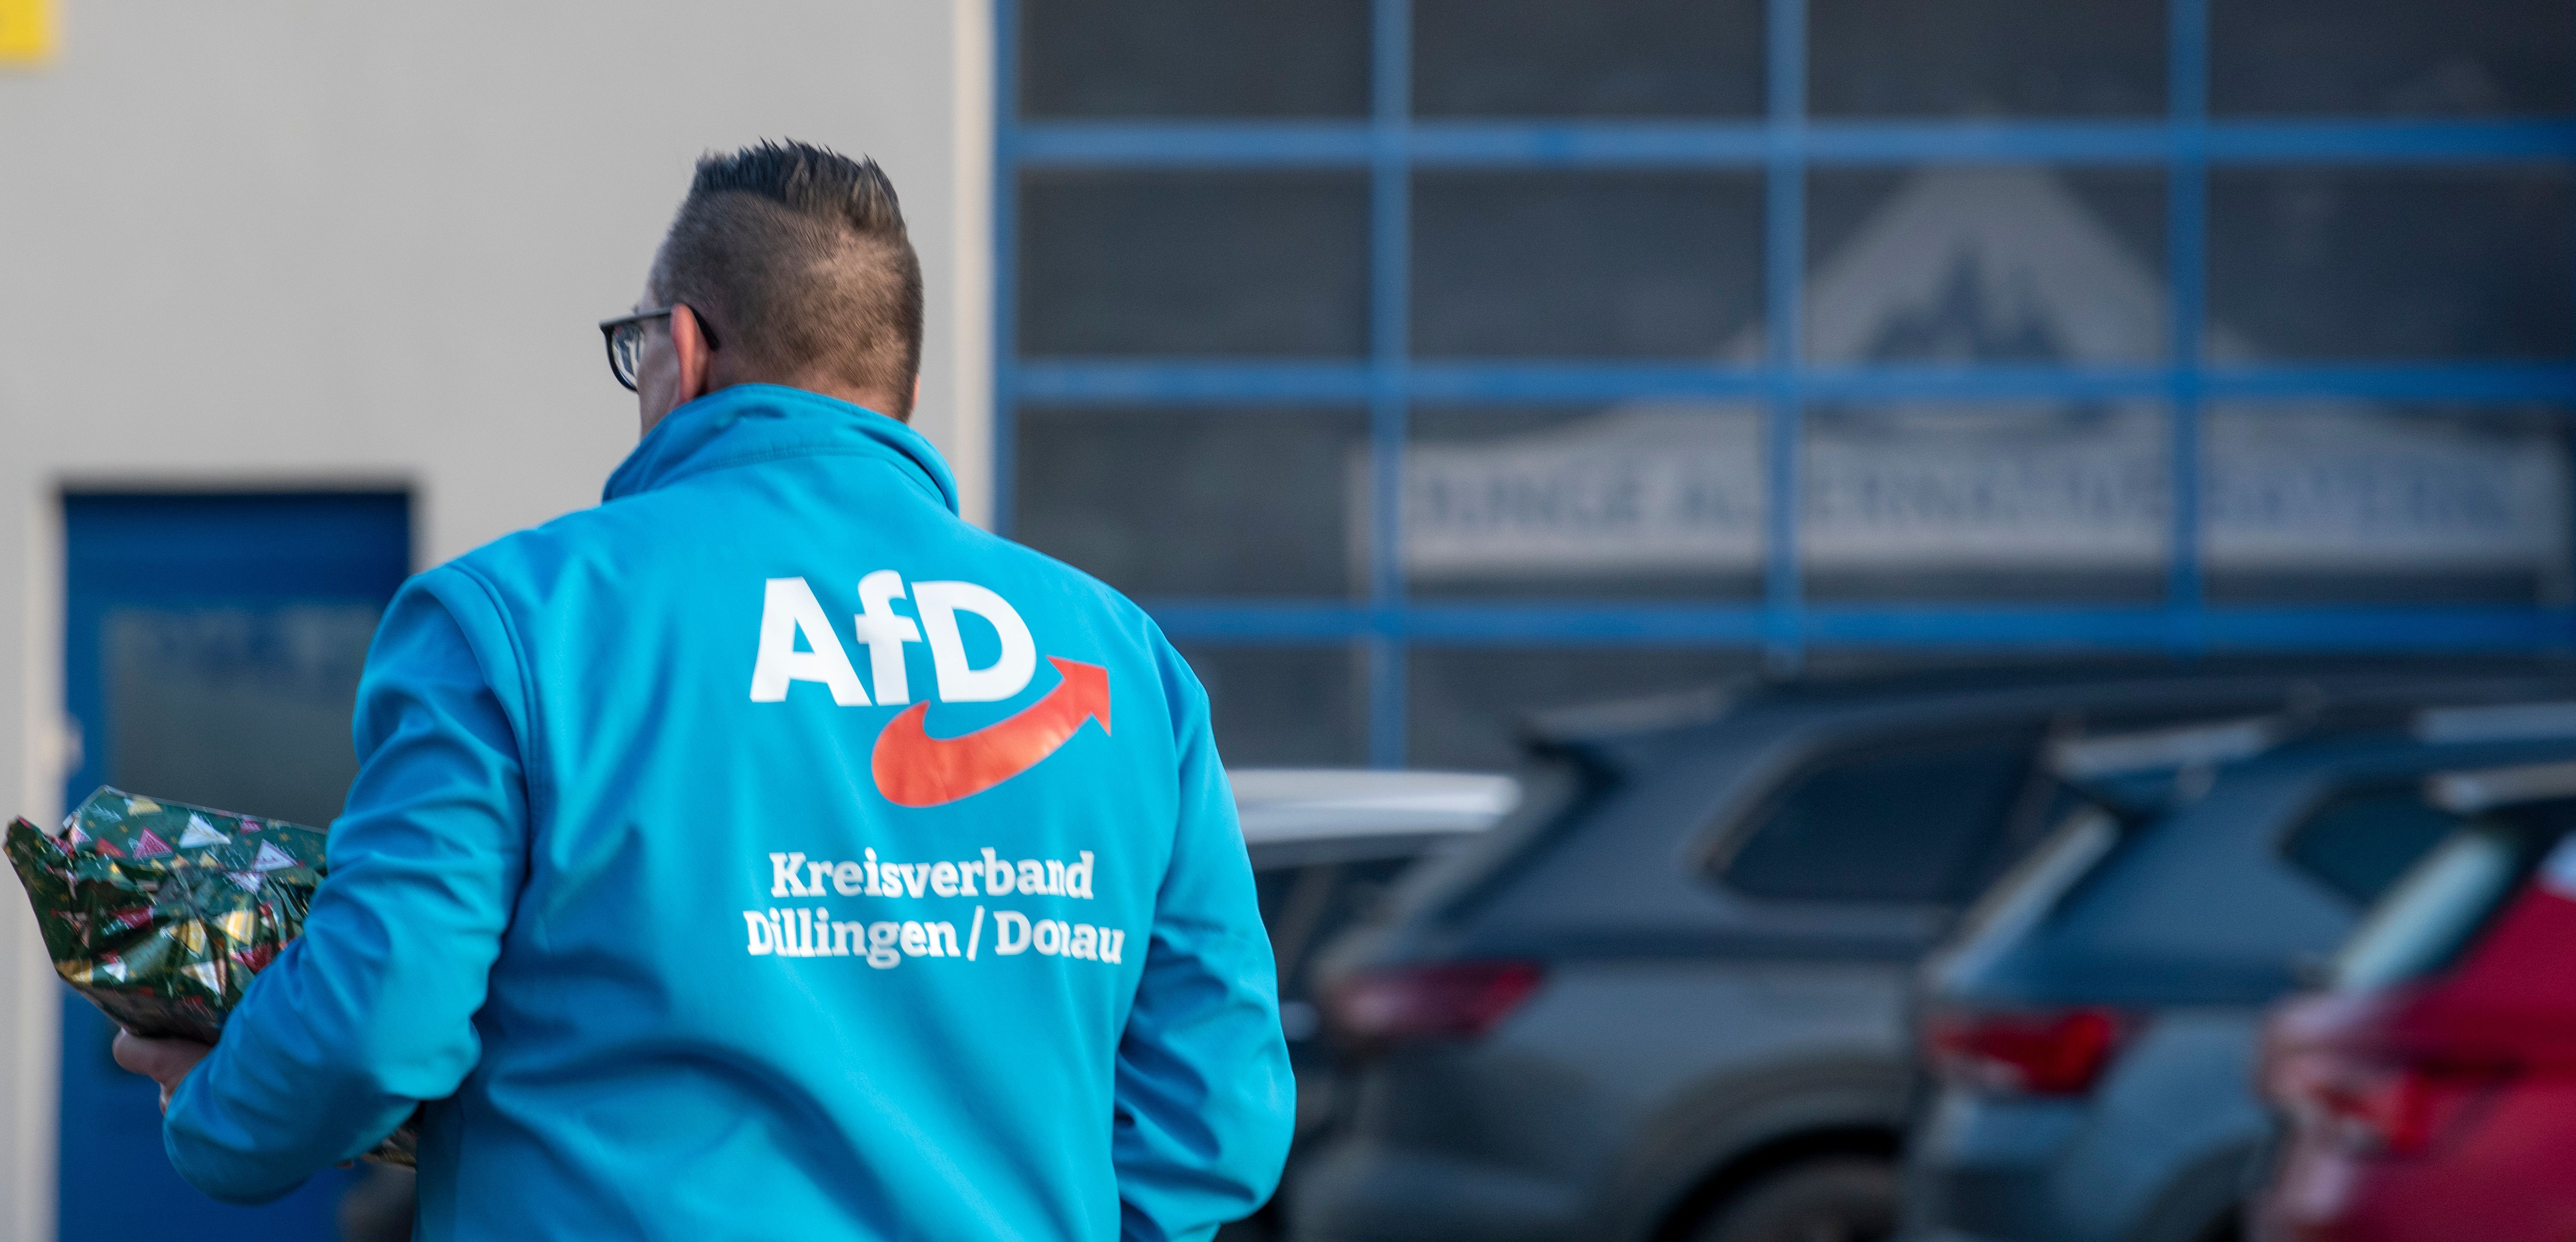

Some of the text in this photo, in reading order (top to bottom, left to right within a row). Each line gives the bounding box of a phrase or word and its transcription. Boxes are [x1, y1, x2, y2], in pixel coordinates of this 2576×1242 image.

[750, 570, 1036, 706] AfD
[769, 847, 1094, 899] Kreisverband
[743, 907, 961, 969] Dillingen
[966, 905, 985, 961] /
